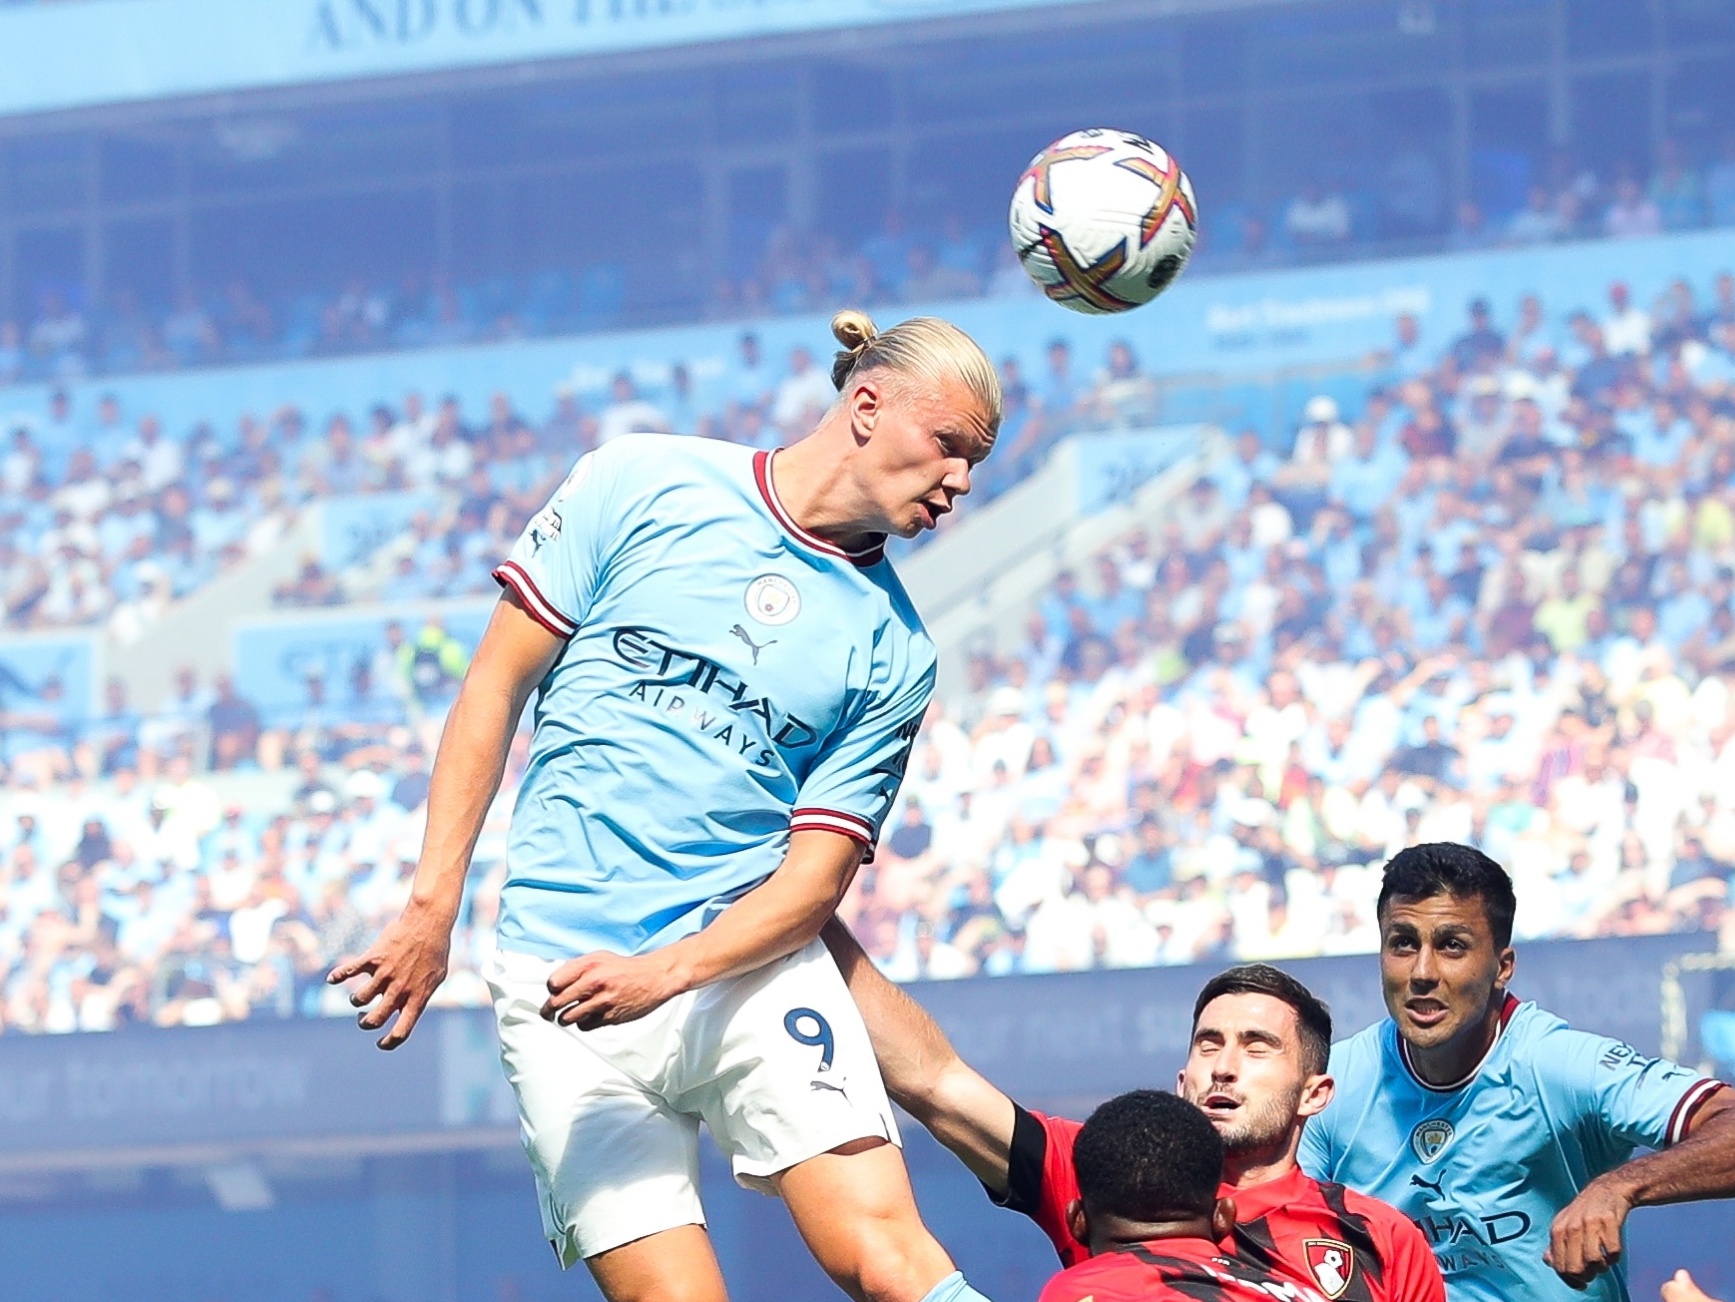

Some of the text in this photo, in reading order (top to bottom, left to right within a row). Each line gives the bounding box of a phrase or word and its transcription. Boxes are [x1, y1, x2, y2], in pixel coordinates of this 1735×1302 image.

[612, 628, 817, 749] ETIHAD
[628, 680, 776, 767] AIRWAYS
[783, 1006, 835, 1073] 9
